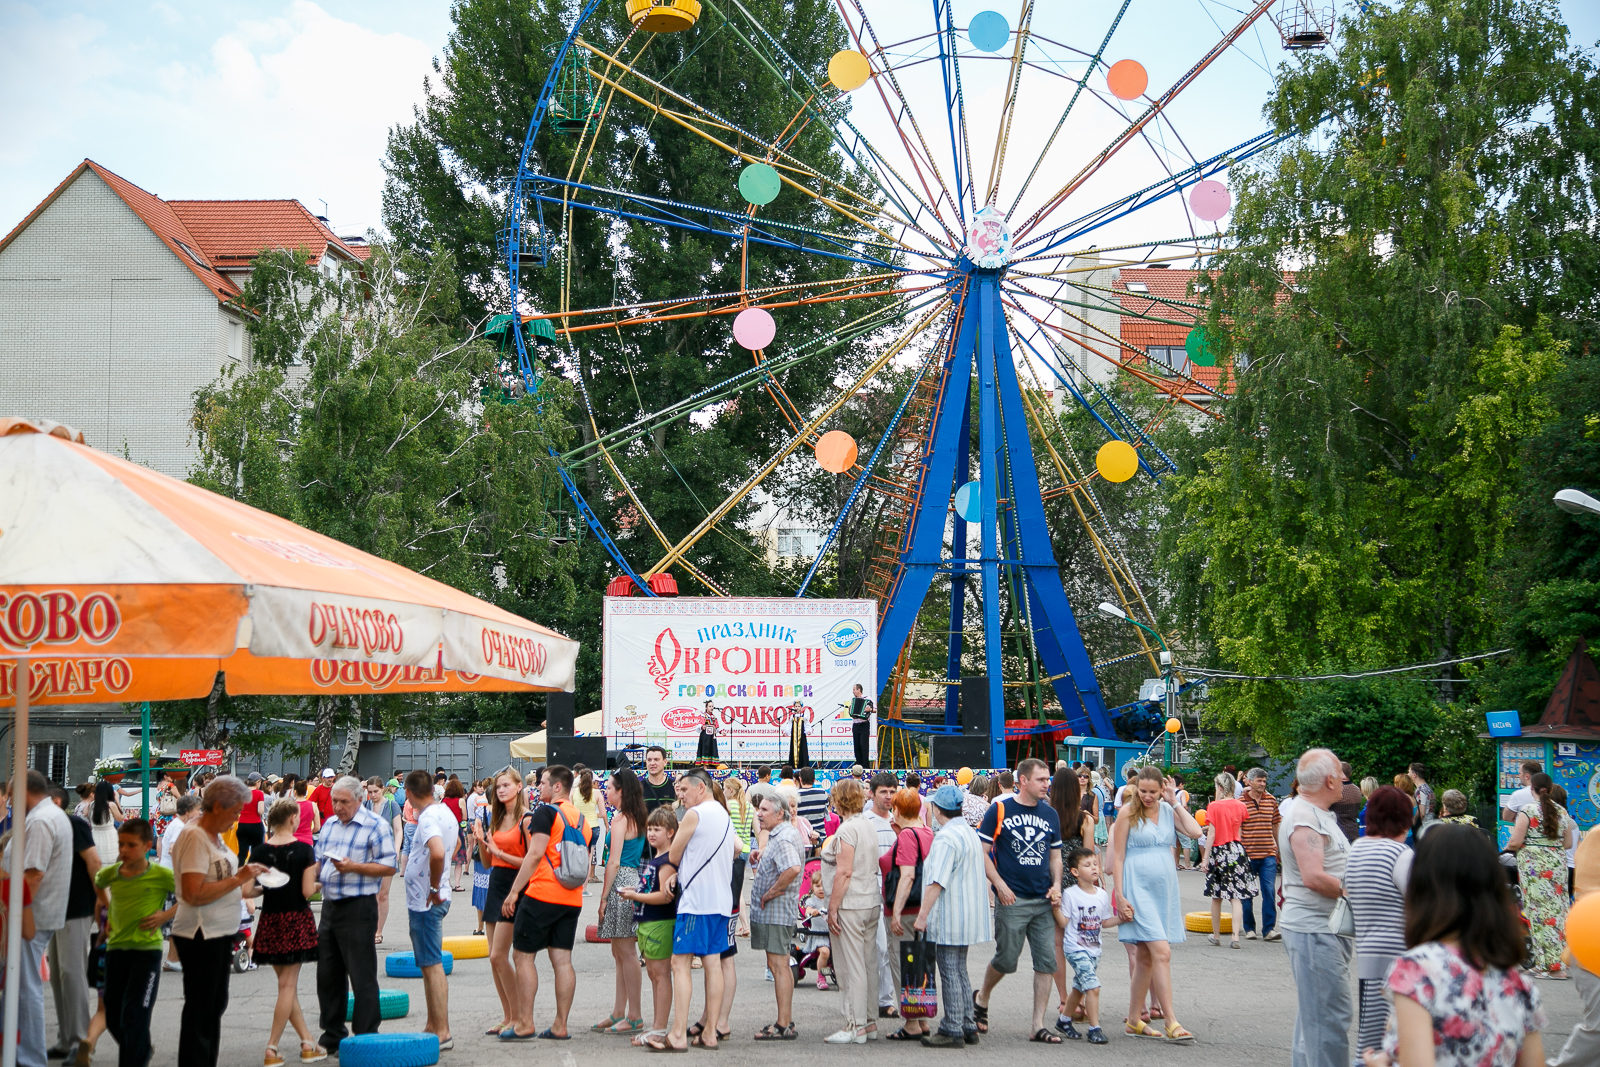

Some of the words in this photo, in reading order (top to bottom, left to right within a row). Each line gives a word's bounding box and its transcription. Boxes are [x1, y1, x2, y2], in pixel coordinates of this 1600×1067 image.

[309, 602, 403, 656] ОЧАКОВО
[697, 622, 797, 643] ПРАЗДНИК
[481, 627, 547, 677] ОЧАКОВО
[678, 681, 768, 698] ГОРОДСКОЙ
[773, 684, 814, 698] ПАРК
[830, 726, 853, 734] ГОР
[1025, 827, 1036, 841] P
